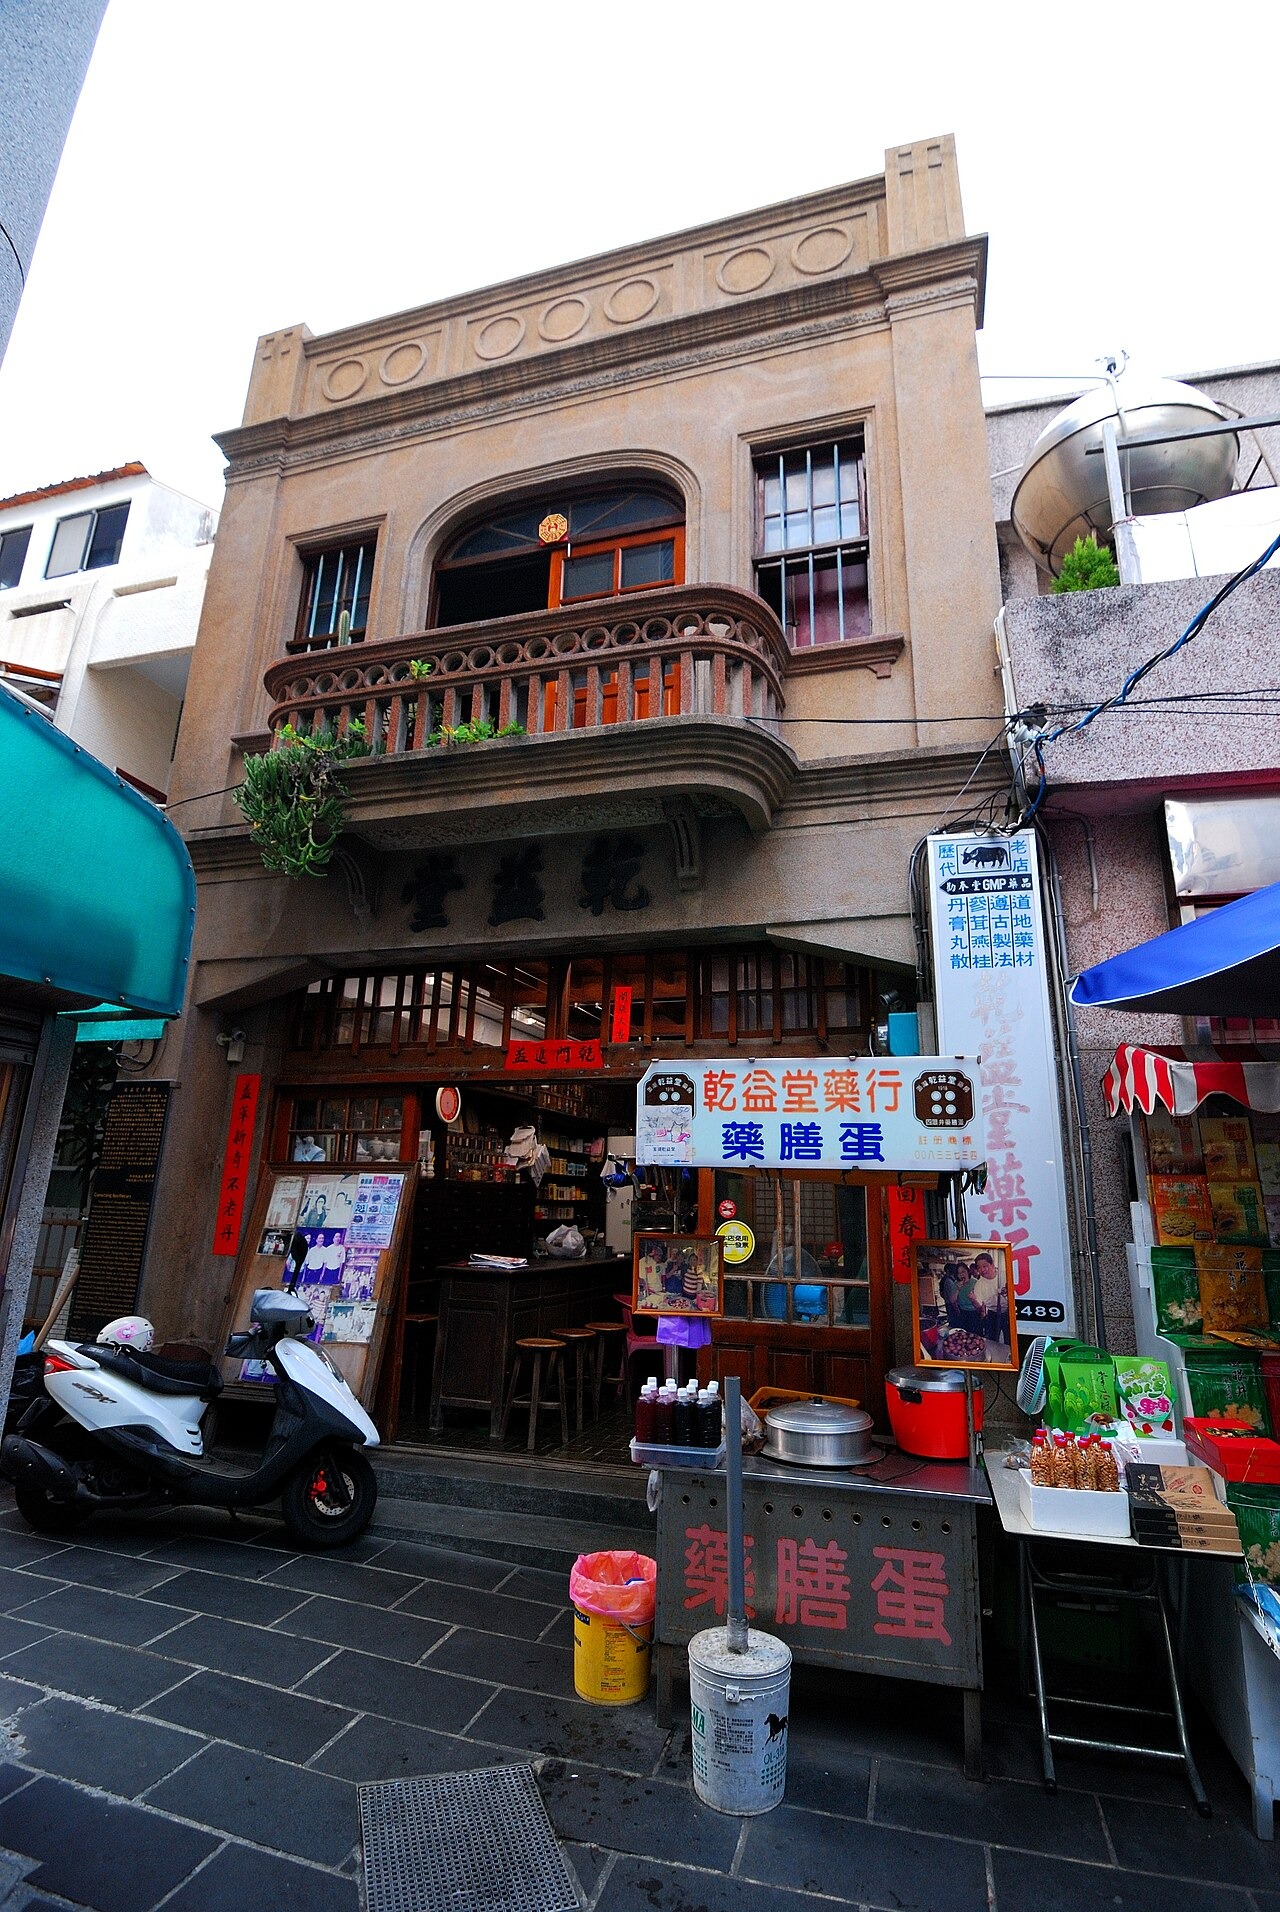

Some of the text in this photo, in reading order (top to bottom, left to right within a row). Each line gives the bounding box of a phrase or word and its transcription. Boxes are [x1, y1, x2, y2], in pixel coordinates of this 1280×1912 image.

[1010, 839, 1029, 873] 老店
[947, 897, 970, 970] 丹膏丸散
[990, 894, 1013, 968] 遵古製法
[1012, 894, 1035, 968] 道地藥材
[702, 1068, 903, 1114] 乾益堂藥行
[721, 1121, 885, 1162] 藥膳蛋
[1015, 1305, 1061, 1318] 489
[684, 1523, 952, 1646] 藥膳蛋
